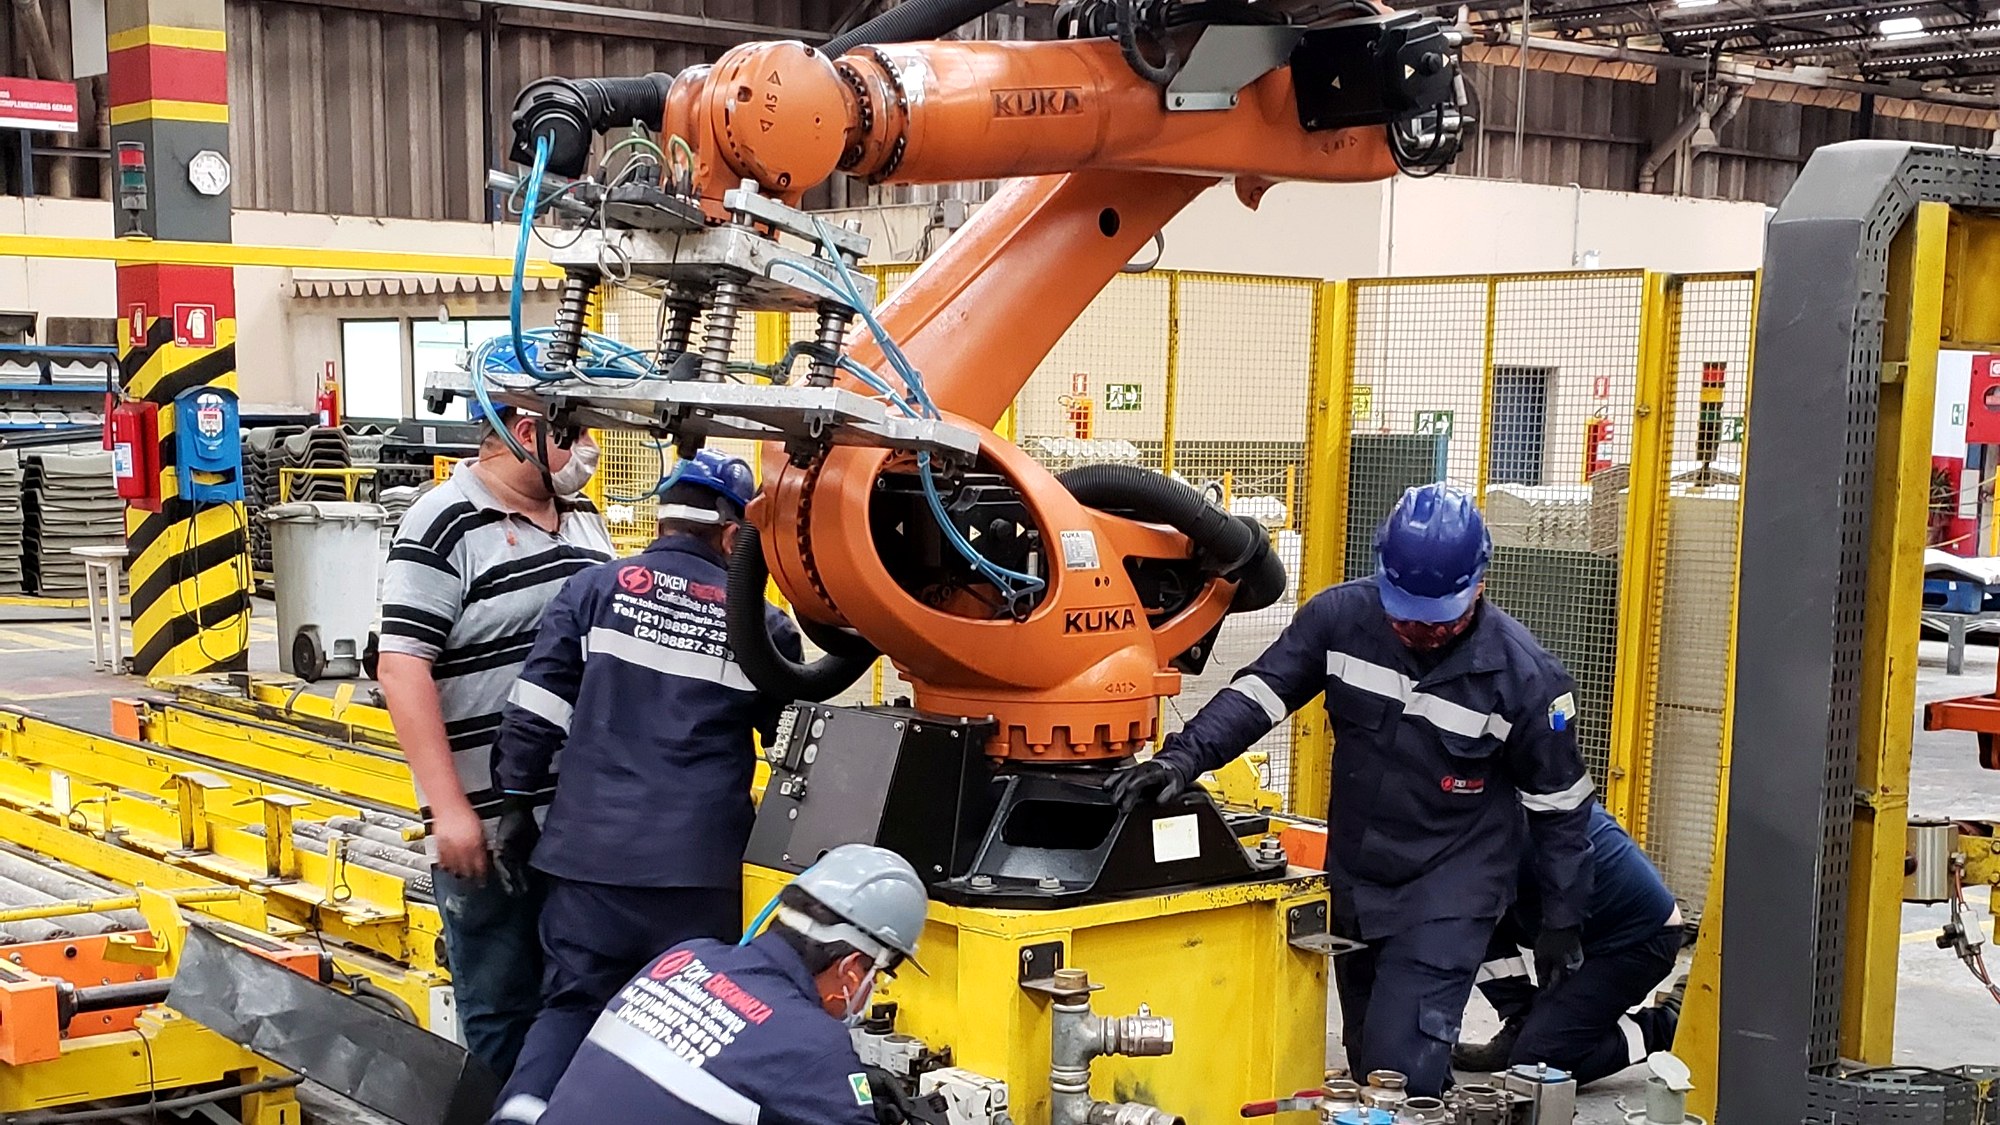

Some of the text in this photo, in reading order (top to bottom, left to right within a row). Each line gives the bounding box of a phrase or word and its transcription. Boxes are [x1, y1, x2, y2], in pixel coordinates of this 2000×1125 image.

[765, 93, 778, 113] A5
[995, 90, 1082, 116] KUKA
[653, 570, 688, 592] TOKEN
[702, 604, 708, 613] e
[1065, 608, 1136, 634] KUKA
[1115, 683, 1127, 693] A1
